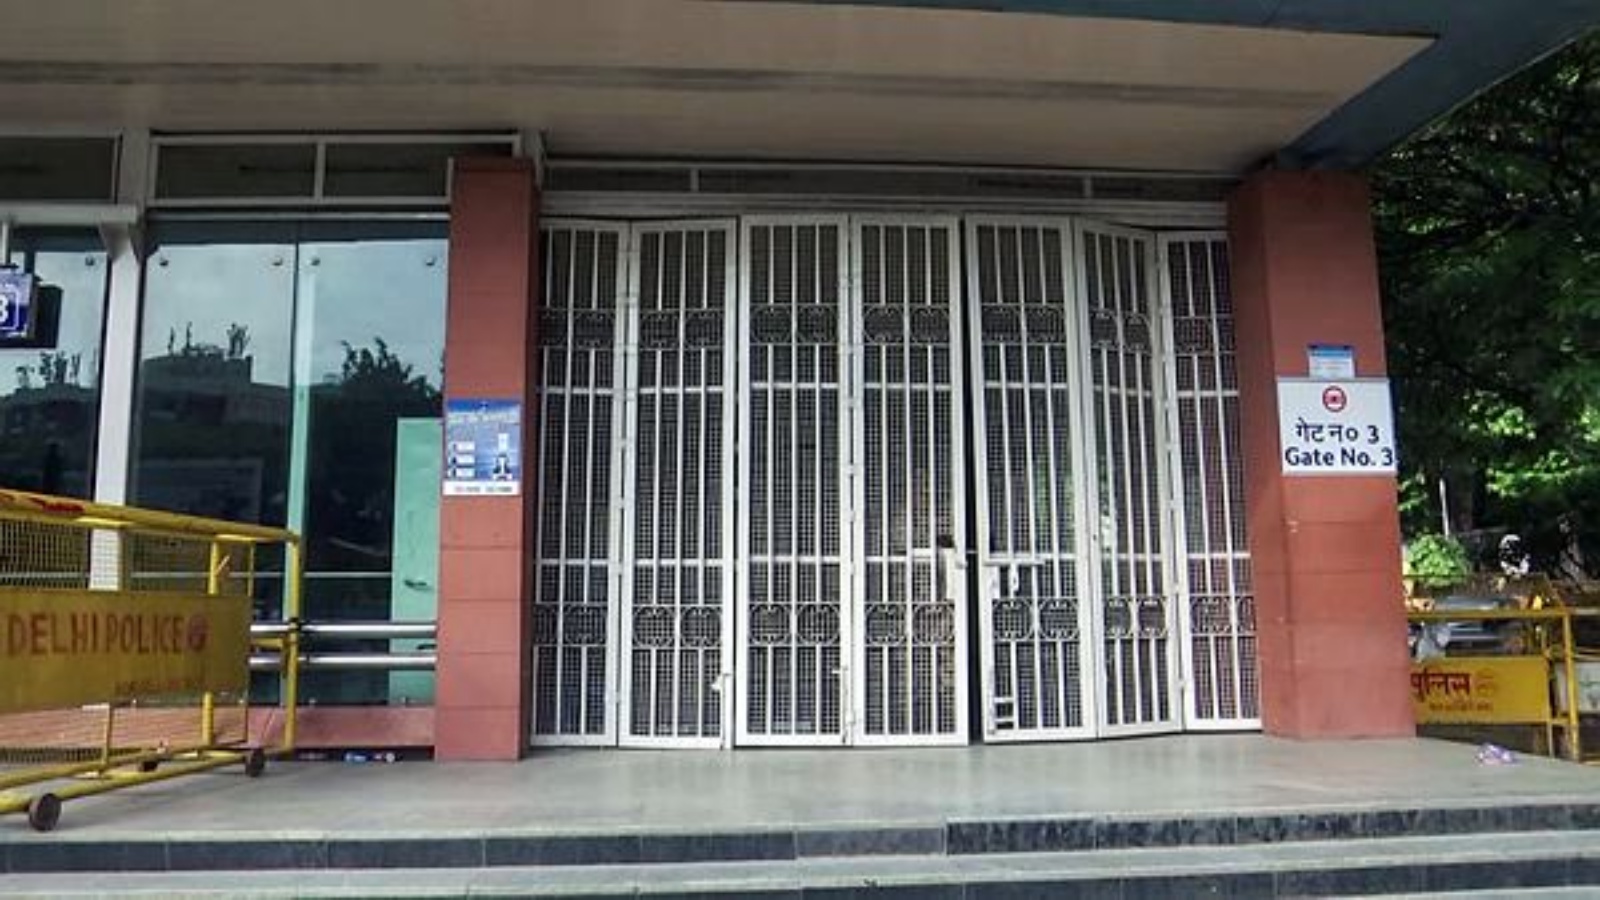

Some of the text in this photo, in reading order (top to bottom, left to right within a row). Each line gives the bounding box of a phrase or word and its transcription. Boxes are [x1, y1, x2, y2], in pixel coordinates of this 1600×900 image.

[1295, 417, 1325, 442] गेट
[1285, 447, 1394, 466] Gate No. 3
[6, 612, 184, 656] DELHI POLICE
[1410, 667, 1470, 703] पुलिस
